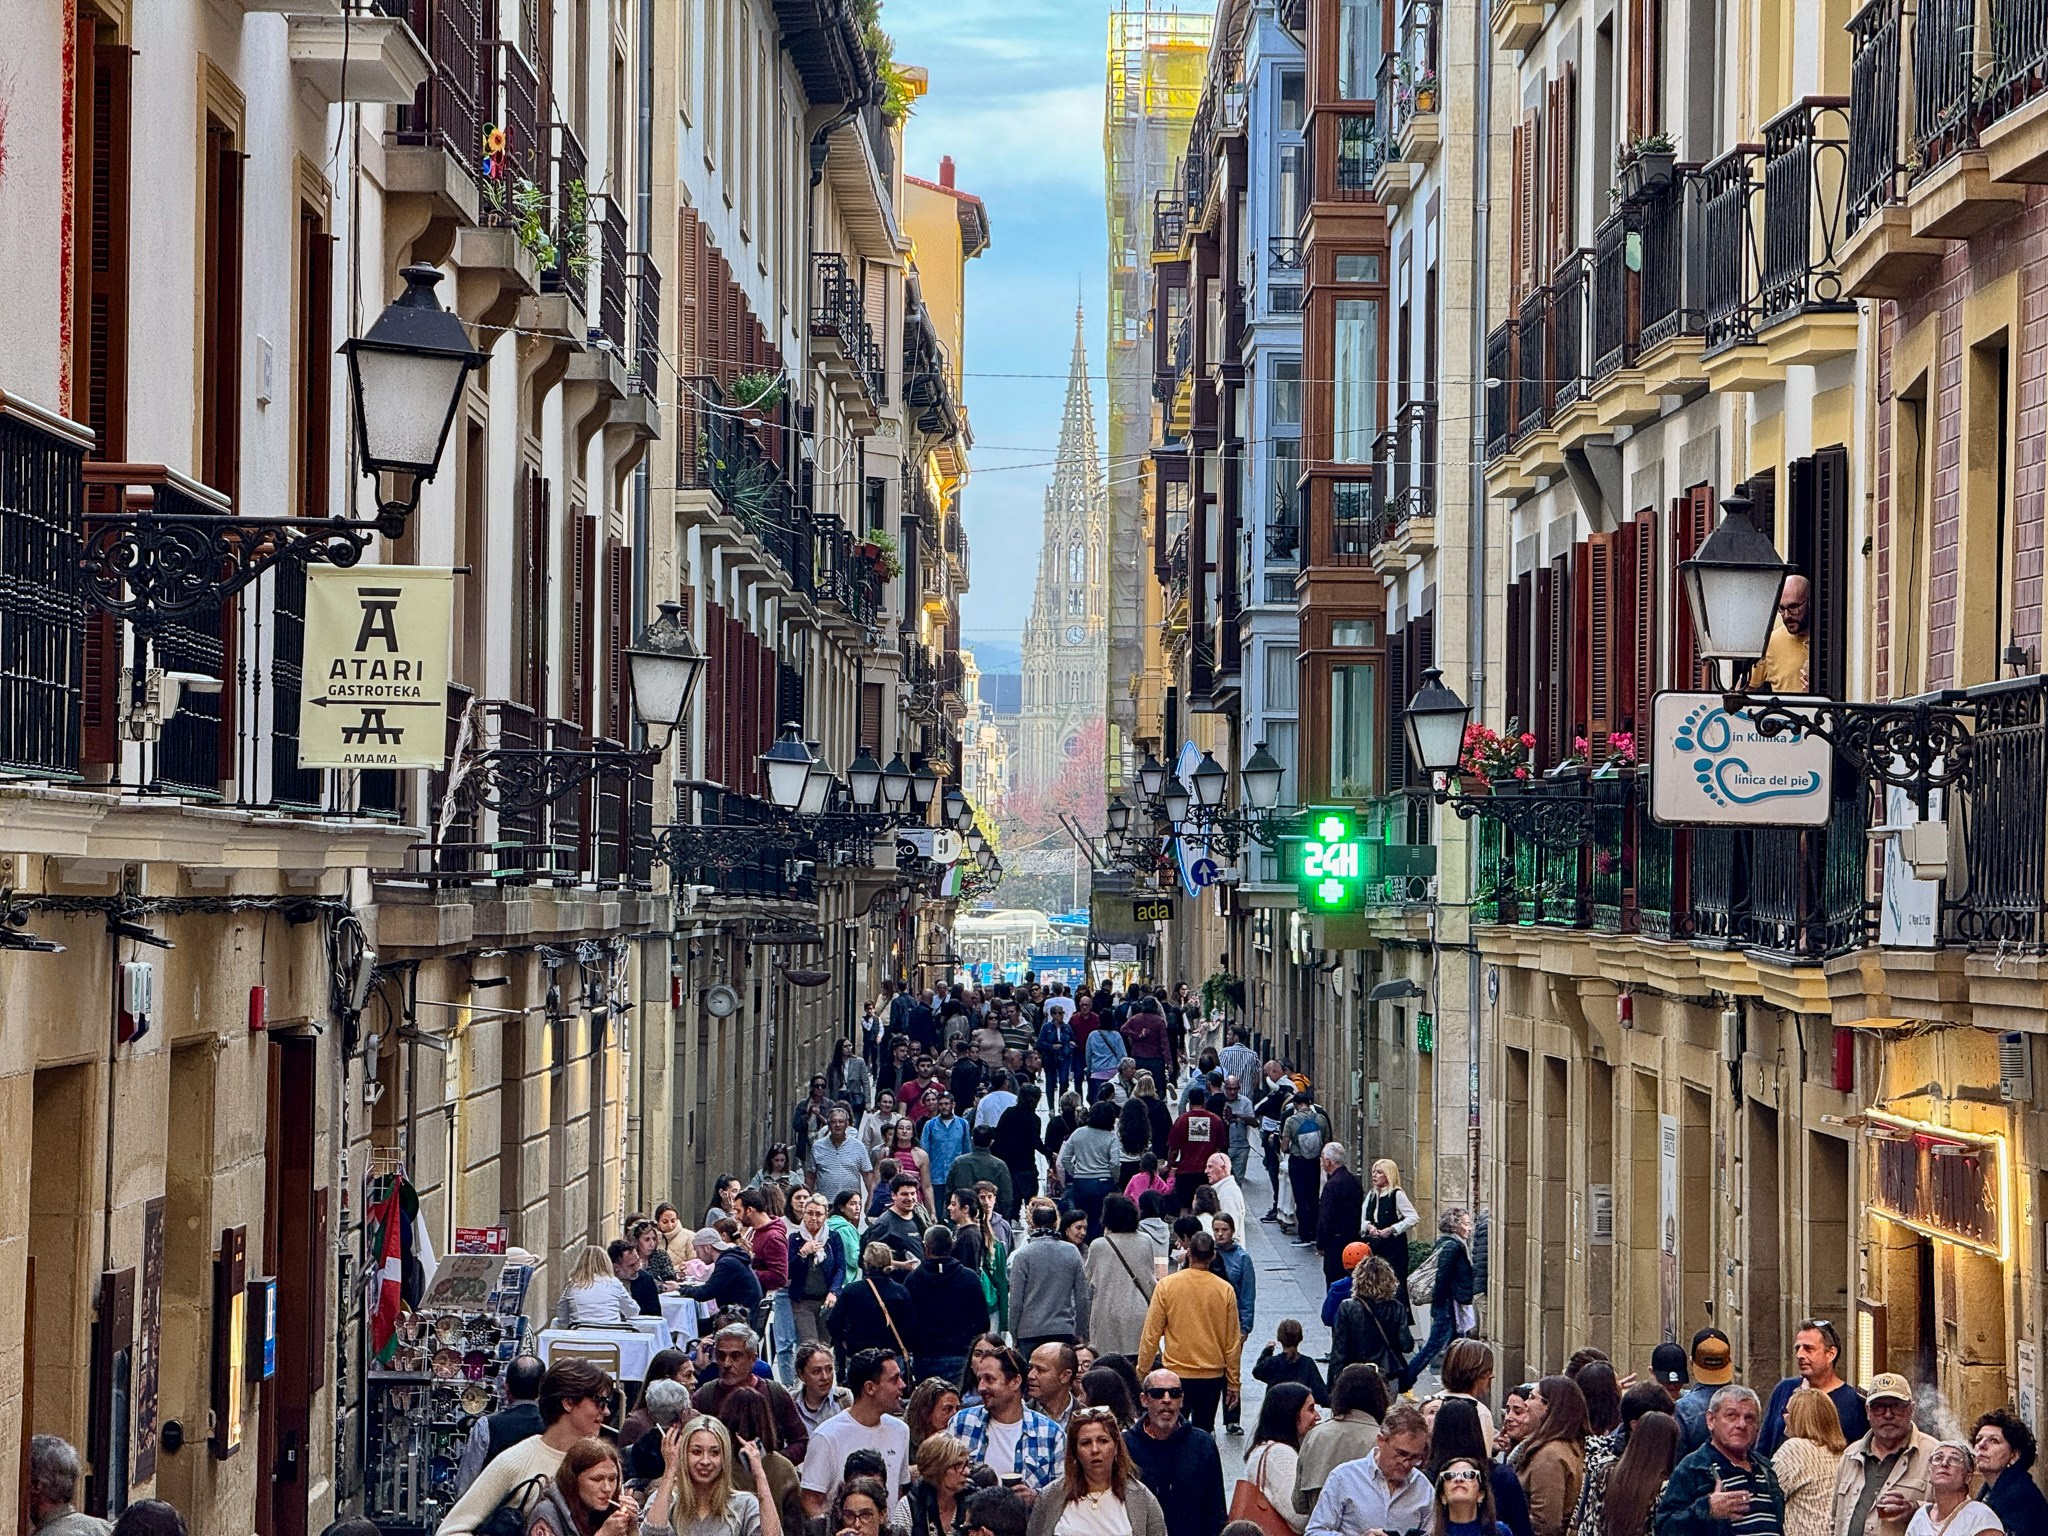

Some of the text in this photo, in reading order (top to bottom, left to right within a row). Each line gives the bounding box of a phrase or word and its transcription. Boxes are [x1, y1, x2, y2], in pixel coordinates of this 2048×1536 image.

[329, 658, 423, 681] ATARI
[328, 684, 421, 697] GASTROTEKA
[344, 753, 397, 763] AMAMA
[1769, 775, 1787, 786] del
[1790, 776, 1809, 787] pie
[1304, 842, 1359, 877] 24H
[1137, 900, 1169, 920] ada
